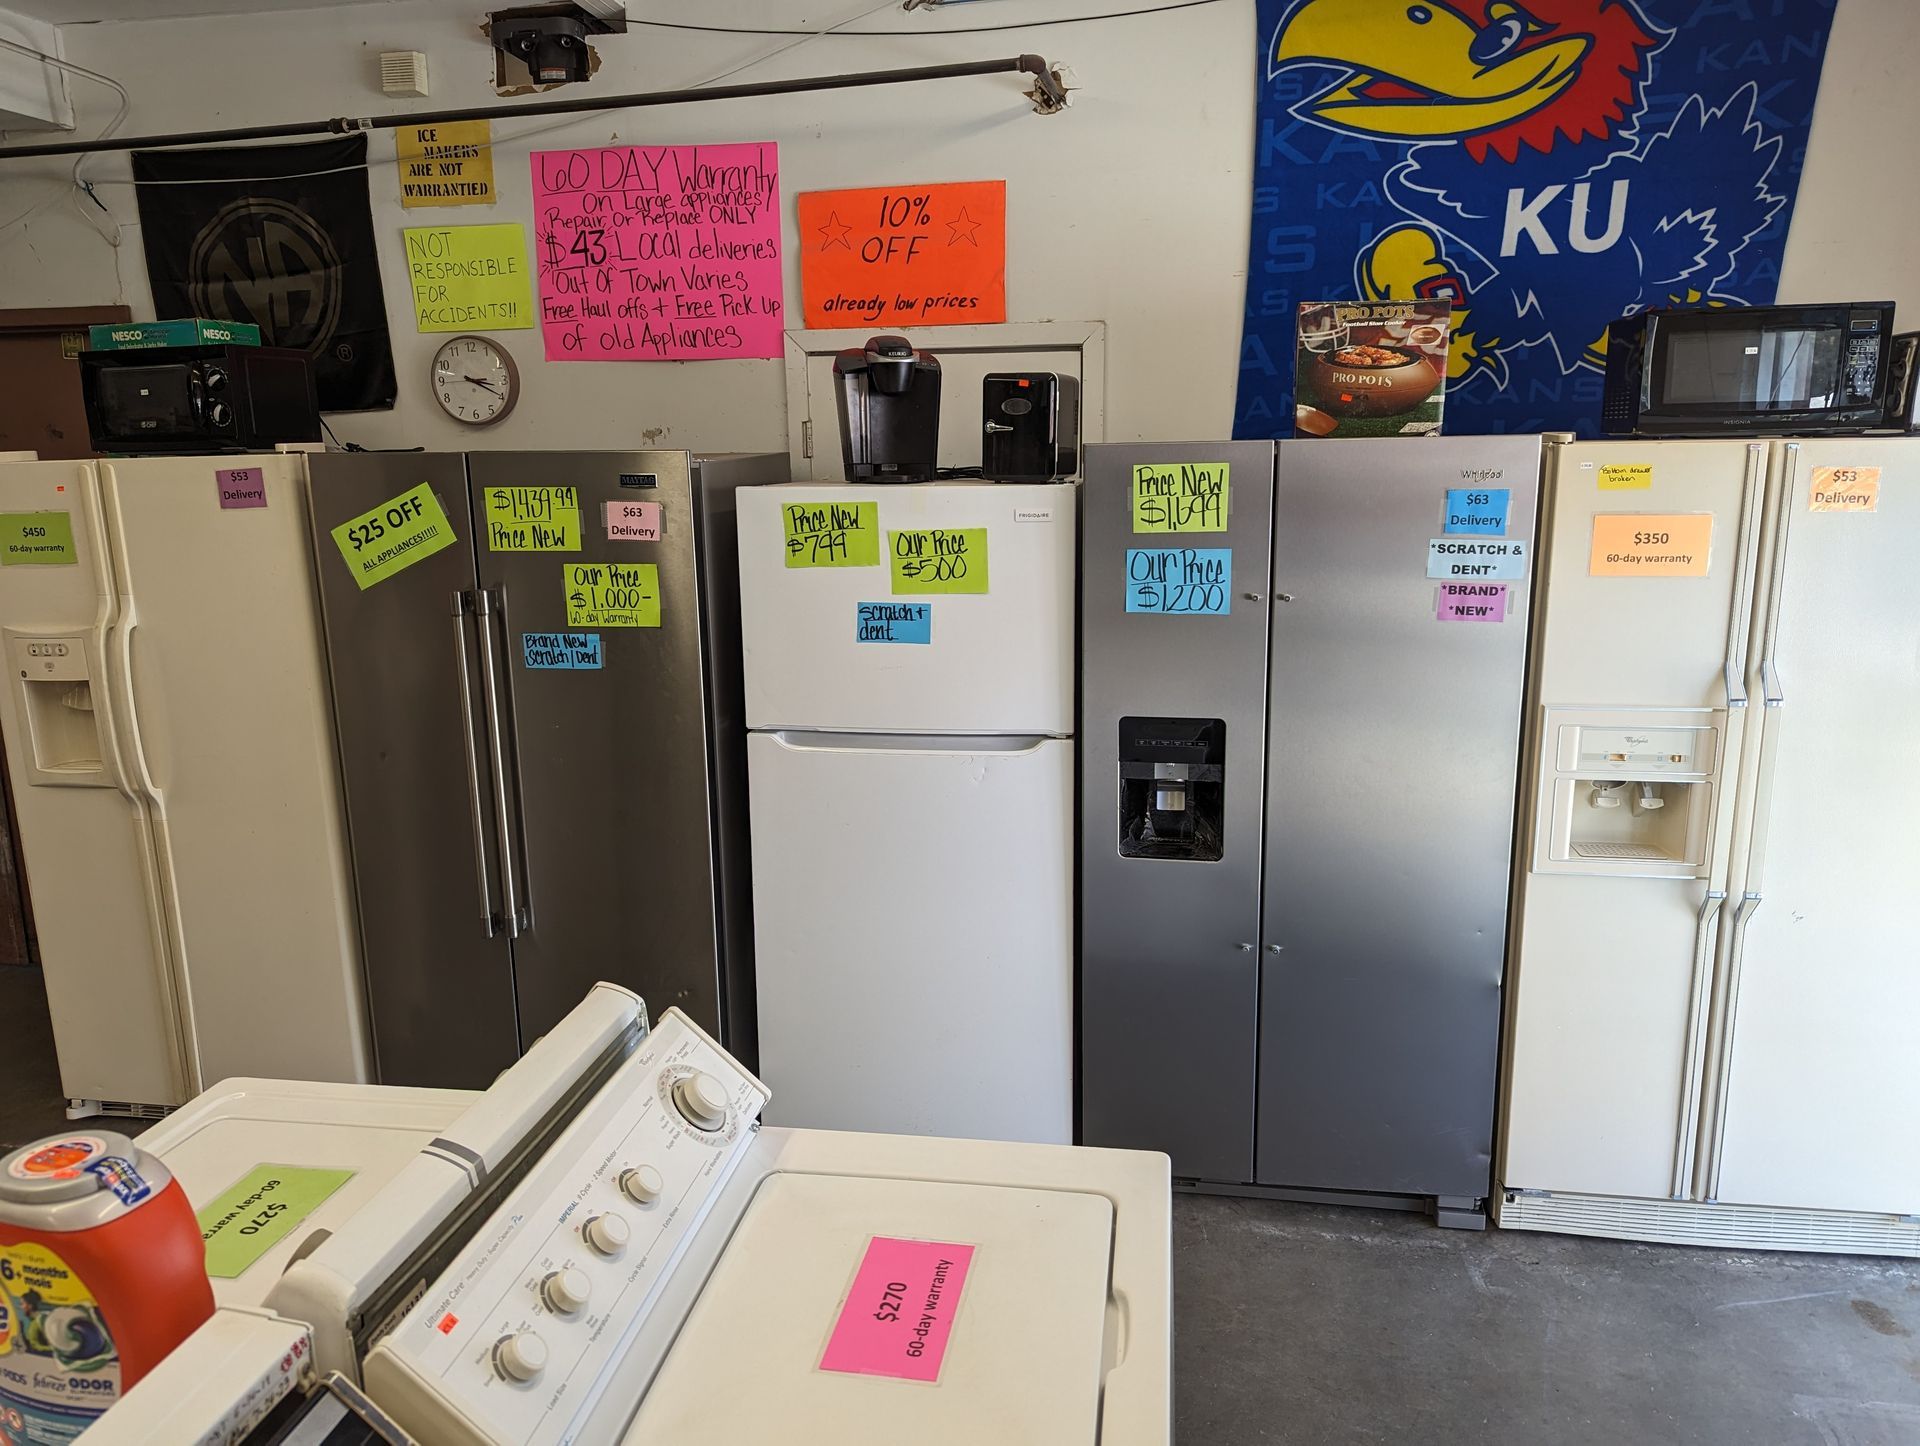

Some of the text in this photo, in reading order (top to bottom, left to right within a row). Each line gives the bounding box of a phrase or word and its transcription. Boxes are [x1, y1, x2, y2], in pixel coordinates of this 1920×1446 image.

[418, 129, 437, 142] ICE
[424, 145, 478, 159] MAKERS
[409, 163, 463, 176] ARE NOT
[542, 148, 776, 212] 60 DAY Warranty
[404, 183, 487, 196] WARRANTIED
[583, 191, 762, 216] On Large appliances
[880, 194, 930, 228] 10%
[545, 206, 756, 234] Repair Or Replace ONLY
[1500, 179, 1629, 257] KU
[410, 233, 451, 259] NOT
[689, 228, 777, 259] deliveries
[861, 236, 928, 264] OFF
[414, 257, 516, 279] RESPONSIBLE
[556, 267, 589, 294] Out
[619, 268, 676, 293] Town
[681, 267, 748, 291] Varies
[417, 285, 450, 302] FOR
[419, 303, 516, 325] ACCIDENTS!!
[543, 294, 780, 320] Free Haul offs + Free Pick Up
[823, 293, 979, 321] already low prices
[1337, 305, 1414, 321] PRO POTS
[112, 330, 142, 341] NESCO
[203, 329, 230, 340] NESCO
[563, 323, 742, 355] of old Appliances
[449, 346, 458, 356] 11
[465, 342, 476, 352] 12
[484, 347, 488, 356] 1
[439, 360, 449, 370] 10
[438, 377, 444, 386] 9
[1333, 372, 1392, 387] PRO POTS
[444, 393, 450, 403] 8
[458, 407, 464, 416] 7
[473, 410, 479, 419] 6
[488, 405, 494, 416] 5
[231, 471, 249, 483] $53
[1137, 465, 1223, 496] Price New
[1462, 469, 1503, 482] Whirlpool
[1833, 470, 1857, 483] $53
[224, 489, 262, 500] Delivery
[1466, 493, 1488, 506] $63
[1815, 492, 1870, 506] Delivery
[623, 507, 642, 517] $63
[788, 505, 859, 533] Price New
[349, 496, 422, 551] $25 OFF
[1451, 515, 1501, 528] Delivery
[22, 527, 46, 537] $450
[491, 522, 565, 548] Price New
[612, 526, 655, 539] Delivery
[1634, 532, 1669, 546] $350
[9, 544, 64, 553] 60-day warranty
[788, 531, 847, 562] $799
[896, 530, 968, 558] Our Price
[1512, 546, 1522, 555] &
[362, 559, 377, 571] ALL
[1130, 549, 1225, 584] Our Price
[1606, 553, 1692, 565] 60-day warranty
[574, 565, 642, 588] Our Price
[903, 557, 967, 582] $500
[570, 611, 599, 626] 60-day
[916, 606, 927, 619] +
[860, 621, 893, 640] dent
[525, 634, 587, 649] Brand New
[559, 1201, 579, 1224] IMPERIAL
[580, 1183, 592, 1197] Cycle
[595, 1163, 608, 1177] Speed
[606, 1150, 616, 1164] Motor
[203, 1180, 280, 1241] 60-day warra
[240, 1203, 287, 1235] $270
[23, 1265, 68, 1279] months
[24, 1277, 52, 1289] mois
[425, 1299, 450, 1329] Ultimate
[449, 1282, 464, 1300] Care
[873, 1282, 907, 1322] $270
[907, 1259, 954, 1357] 60-day warranty
[69, 1377, 113, 1391] ODOR
